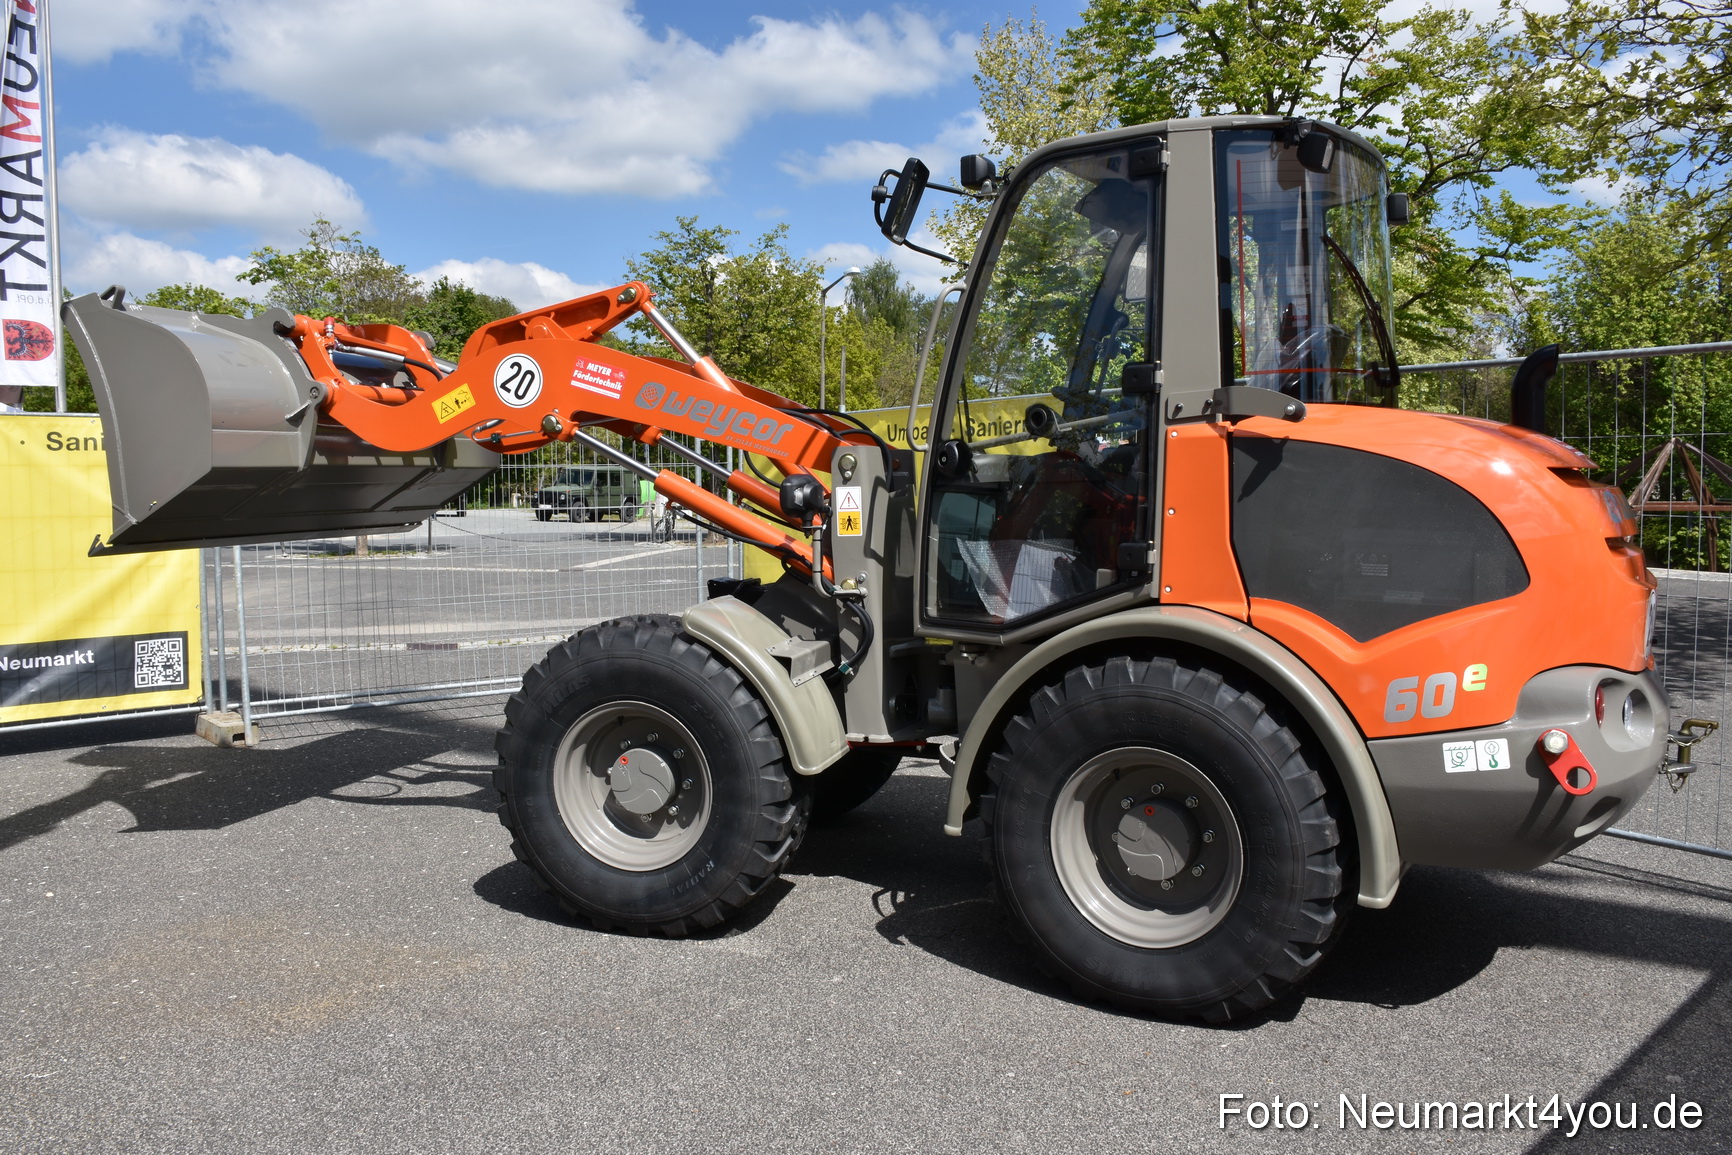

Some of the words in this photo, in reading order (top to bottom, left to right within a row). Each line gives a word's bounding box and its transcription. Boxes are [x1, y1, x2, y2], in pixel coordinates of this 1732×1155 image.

[573, 369, 622, 391] Fördertechnik
[586, 362, 612, 377] MEYER
[500, 361, 535, 400] 20
[660, 391, 794, 445] weycor
[734, 437, 753, 447] ATLAS
[0, 650, 95, 671] Neumarkt
